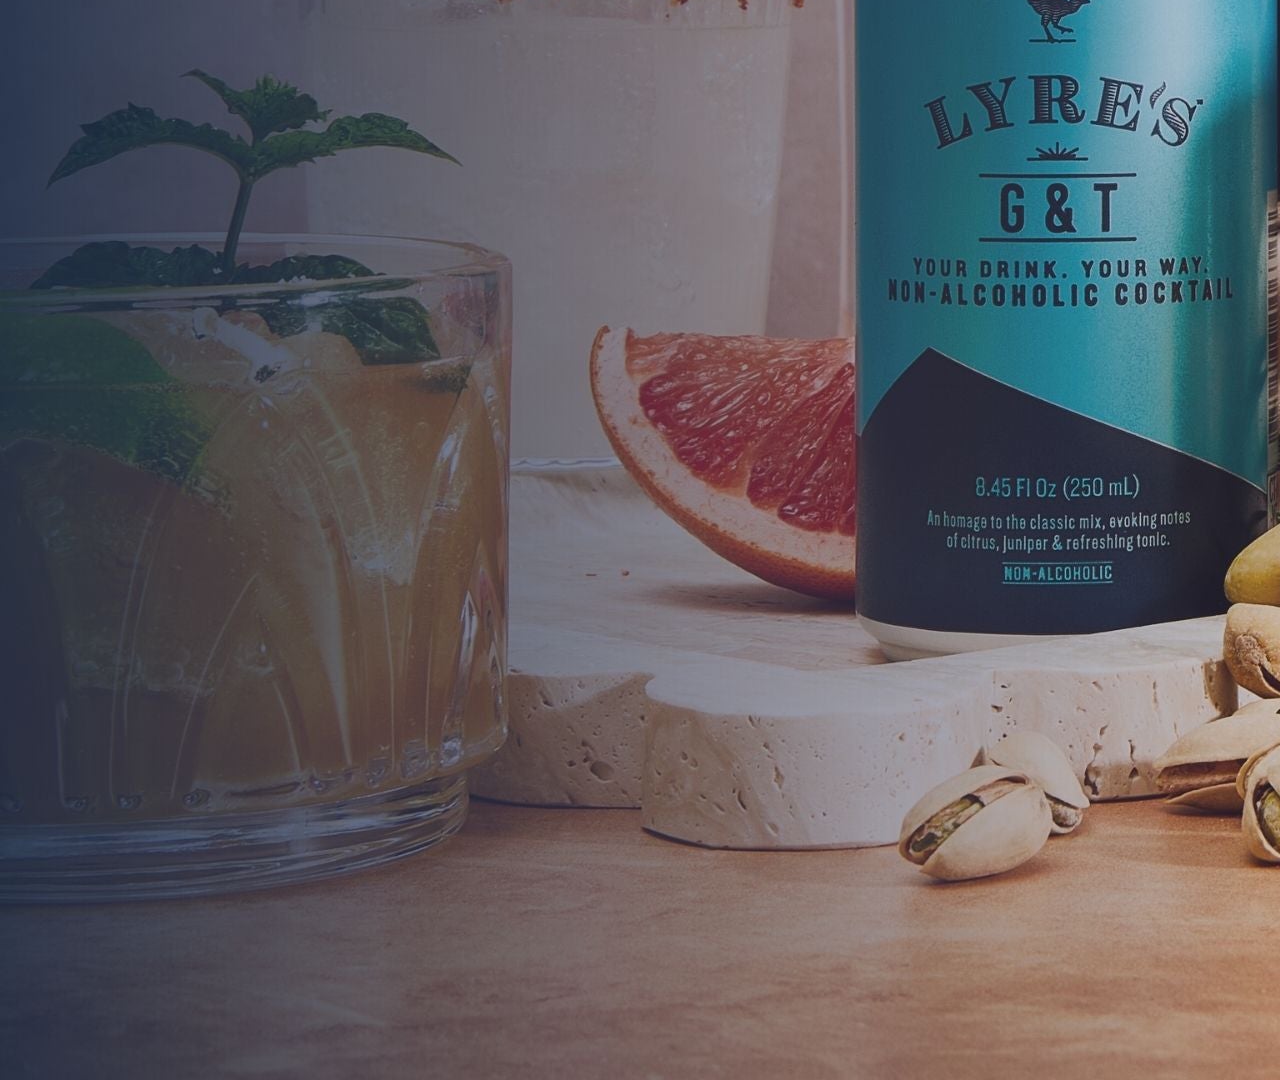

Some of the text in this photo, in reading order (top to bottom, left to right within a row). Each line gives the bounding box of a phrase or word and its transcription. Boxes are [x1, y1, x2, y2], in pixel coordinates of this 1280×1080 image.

[924, 74, 1199, 150] LYRE'S
[1000, 182, 1118, 233] G & T
[913, 256, 1209, 279] YOUR DRINK. YOUR WAY.
[888, 278, 1233, 307] NON-ALCOHOLIC COCKTAIL
[975, 476, 1011, 497] 8.45
[1035, 478, 1056, 498] Oz
[1062, 476, 1104, 501] (250
[1109, 474, 1140, 499] mL)
[927, 509, 1191, 532] An homage to the classic mix, evoking notes
[946, 531, 1170, 554] of citrus, juniper & refreshing tonic.
[1003, 565, 1112, 581] NON-ALCOHOLIC
